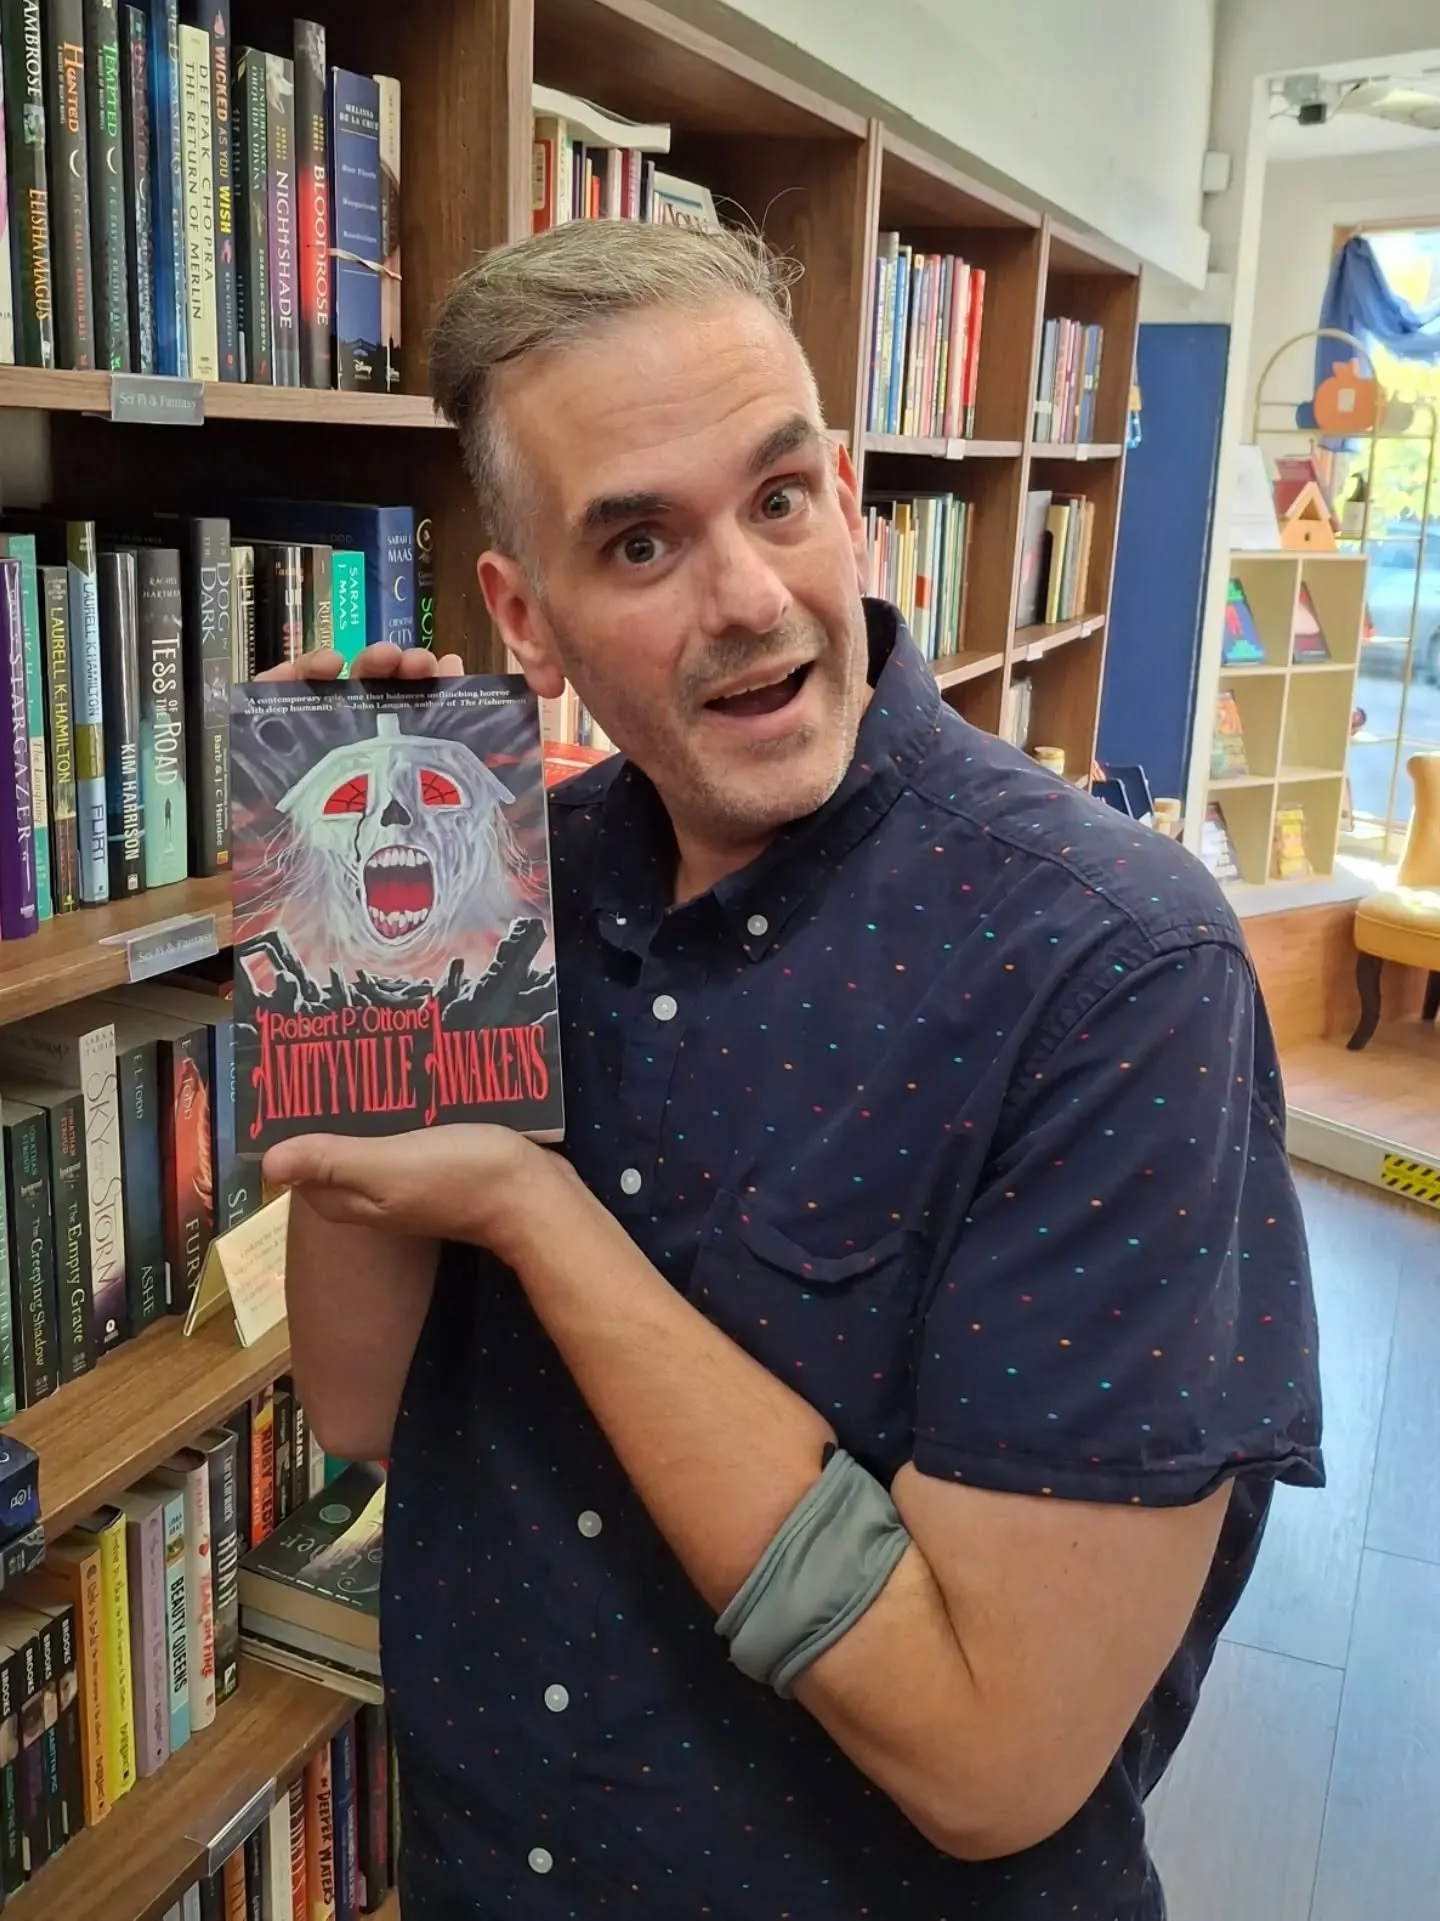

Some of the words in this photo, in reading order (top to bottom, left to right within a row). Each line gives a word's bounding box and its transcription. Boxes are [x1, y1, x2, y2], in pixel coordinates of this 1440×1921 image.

[23, 0, 42, 97] AMBROSE
[103, 41, 120, 137] TEMPTED
[185, 62, 196, 101] THE
[214, 45, 228, 122] WICKED
[199, 65, 211, 158] DEEPAK
[218, 126, 228, 145] AS
[345, 104, 374, 119] MELISSA
[187, 111, 199, 194] RETURN
[219, 150, 230, 178] YOU
[29, 188, 49, 251] ELISHA
[190, 205, 199, 232] OF
[203, 177, 214, 283] CHOPRA
[219, 185, 232, 234] WISH
[276, 170, 292, 329] NIGHTSHADE
[32, 255, 52, 320] MAGUS
[191, 242, 202, 319] MERLIN
[388, 548, 413, 562] MAAS
[83, 582, 98, 638] LAURELL
[201, 566, 217, 645] DARK
[217, 562, 231, 631] DOG
[339, 580, 348, 630] MAAS
[350, 566, 359, 625] SARAH
[51, 608, 67, 679] LAURELL
[152, 632, 180, 695] TESS
[389, 628, 413, 645] CITY
[54, 684, 68, 700] K.
[156, 698, 167, 719] THE
[169, 700, 179, 712] OF
[244, 705, 264, 715] with
[266, 704, 289, 714] deep
[460, 698, 476, 707] The
[256, 694, 321, 707] contemporary
[366, 692, 384, 701] that
[427, 688, 478, 699] unflinching
[480, 688, 511, 697] horror
[10, 651, 31, 843] STARGAZER
[55, 703, 72, 784] HAMILTON
[121, 743, 136, 775] KIM
[154, 722, 182, 785] ROAD
[91, 805, 106, 864] FLIRT
[123, 781, 139, 860] HARRISON
[270, 1012, 339, 1041] Robert
[342, 1007, 361, 1035] P.
[366, 1005, 430, 1032] Ottone
[251, 1006, 417, 1139] AMITYVILLE
[424, 993, 550, 1125] AWAKENS
[86, 1072, 117, 1145] SKY
[135, 1082, 144, 1120] TODD
[68, 1202, 78, 1222] The
[91, 1178, 122, 1297] STORM
[65, 1222, 83, 1284] Empty
[185, 1218, 200, 1290] FURY
[71, 1288, 86, 1344] Grave
[142, 1265, 154, 1316] ASHE
[33, 1311, 48, 1366] Shadow
[261, 1425, 273, 1478] RUBY
[295, 1408, 304, 1469] ELIJAH
[170, 1576, 185, 1634] BEAUTY
[43, 1633, 53, 1680] BROOKS
[62, 1618, 72, 1664] BROOKS
[172, 1634, 188, 1692] QUEENS
[202, 1643, 214, 1677] FIRE
[1, 1668, 11, 1716] BROOKS
[26, 1648, 36, 1695] BROOKS
[317, 1789, 332, 1844] DEEPER
[318, 1846, 334, 1905] WATERS
